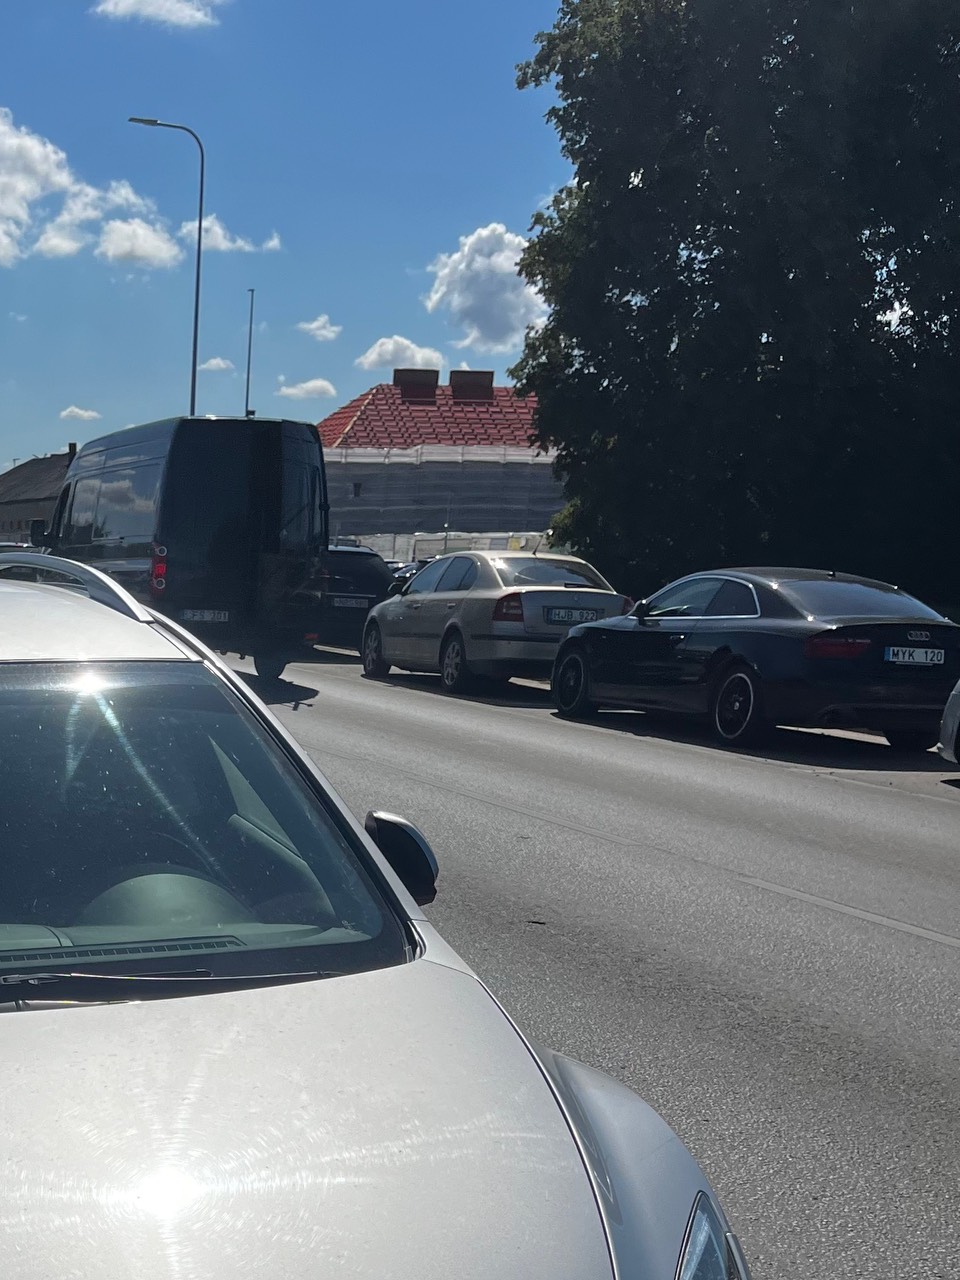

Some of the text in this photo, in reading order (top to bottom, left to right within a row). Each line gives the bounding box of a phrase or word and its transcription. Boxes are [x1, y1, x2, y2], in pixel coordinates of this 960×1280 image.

[553, 609, 596, 621] HJB 922
[892, 648, 943, 662] MYK 120
